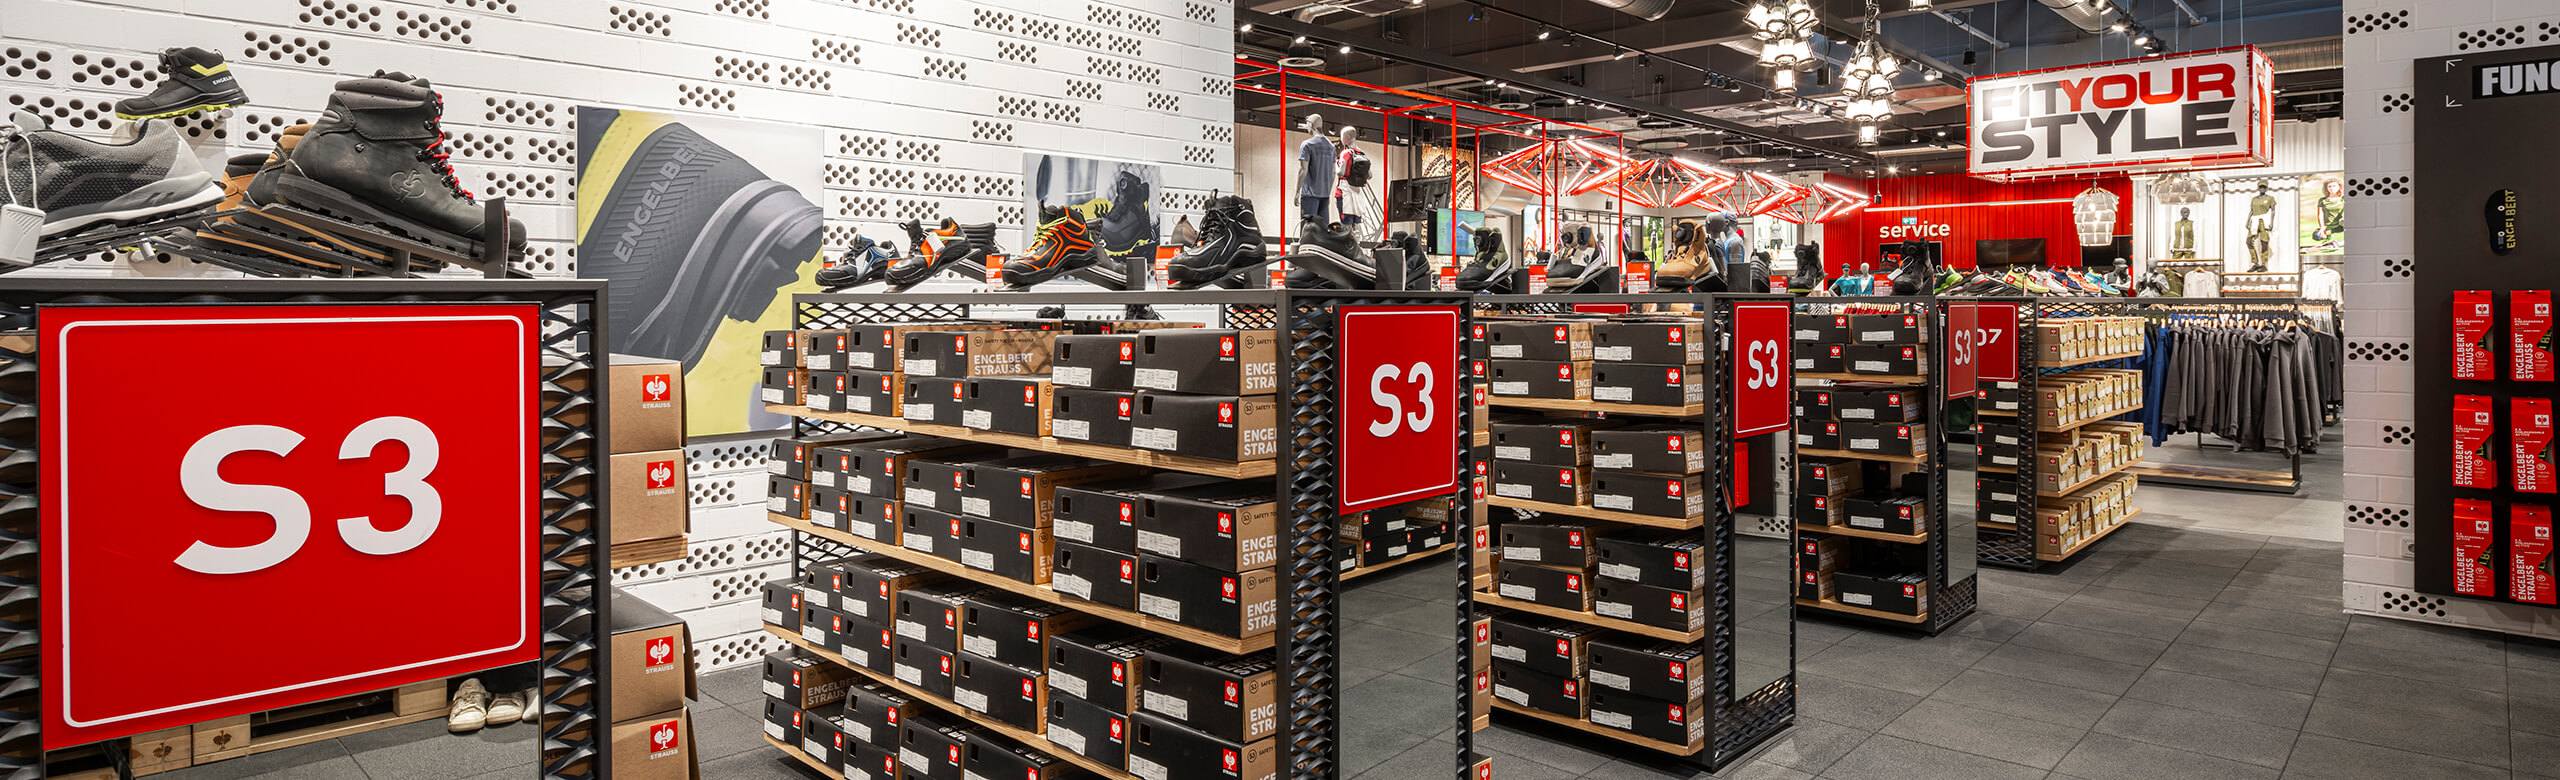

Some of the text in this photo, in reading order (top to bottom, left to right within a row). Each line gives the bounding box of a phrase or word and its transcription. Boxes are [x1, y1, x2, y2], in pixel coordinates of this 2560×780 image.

[1981, 100, 2238, 164] STYLE
[1879, 220, 1950, 238] service
[974, 352, 1034, 364] ENGELBERT
[1747, 339, 1779, 390] S3
[1954, 329, 1971, 366] S3
[2465, 342, 2474, 378] STRAUSS
[2525, 343, 2534, 379] STRAUSS
[974, 363, 1021, 375] STRAUSS
[1369, 361, 1434, 438] S3
[2464, 450, 2473, 485] STRAUSS
[2526, 454, 2536, 490] STRAUSS
[174, 416, 442, 575] S3
[647, 489, 675, 497] STRAUSS
[2466, 558, 2474, 593] STRAUSS
[2526, 565, 2536, 601] STRAUSS
[645, 665, 674, 675] STRAUSS
[650, 749, 679, 760] STRAUSS
